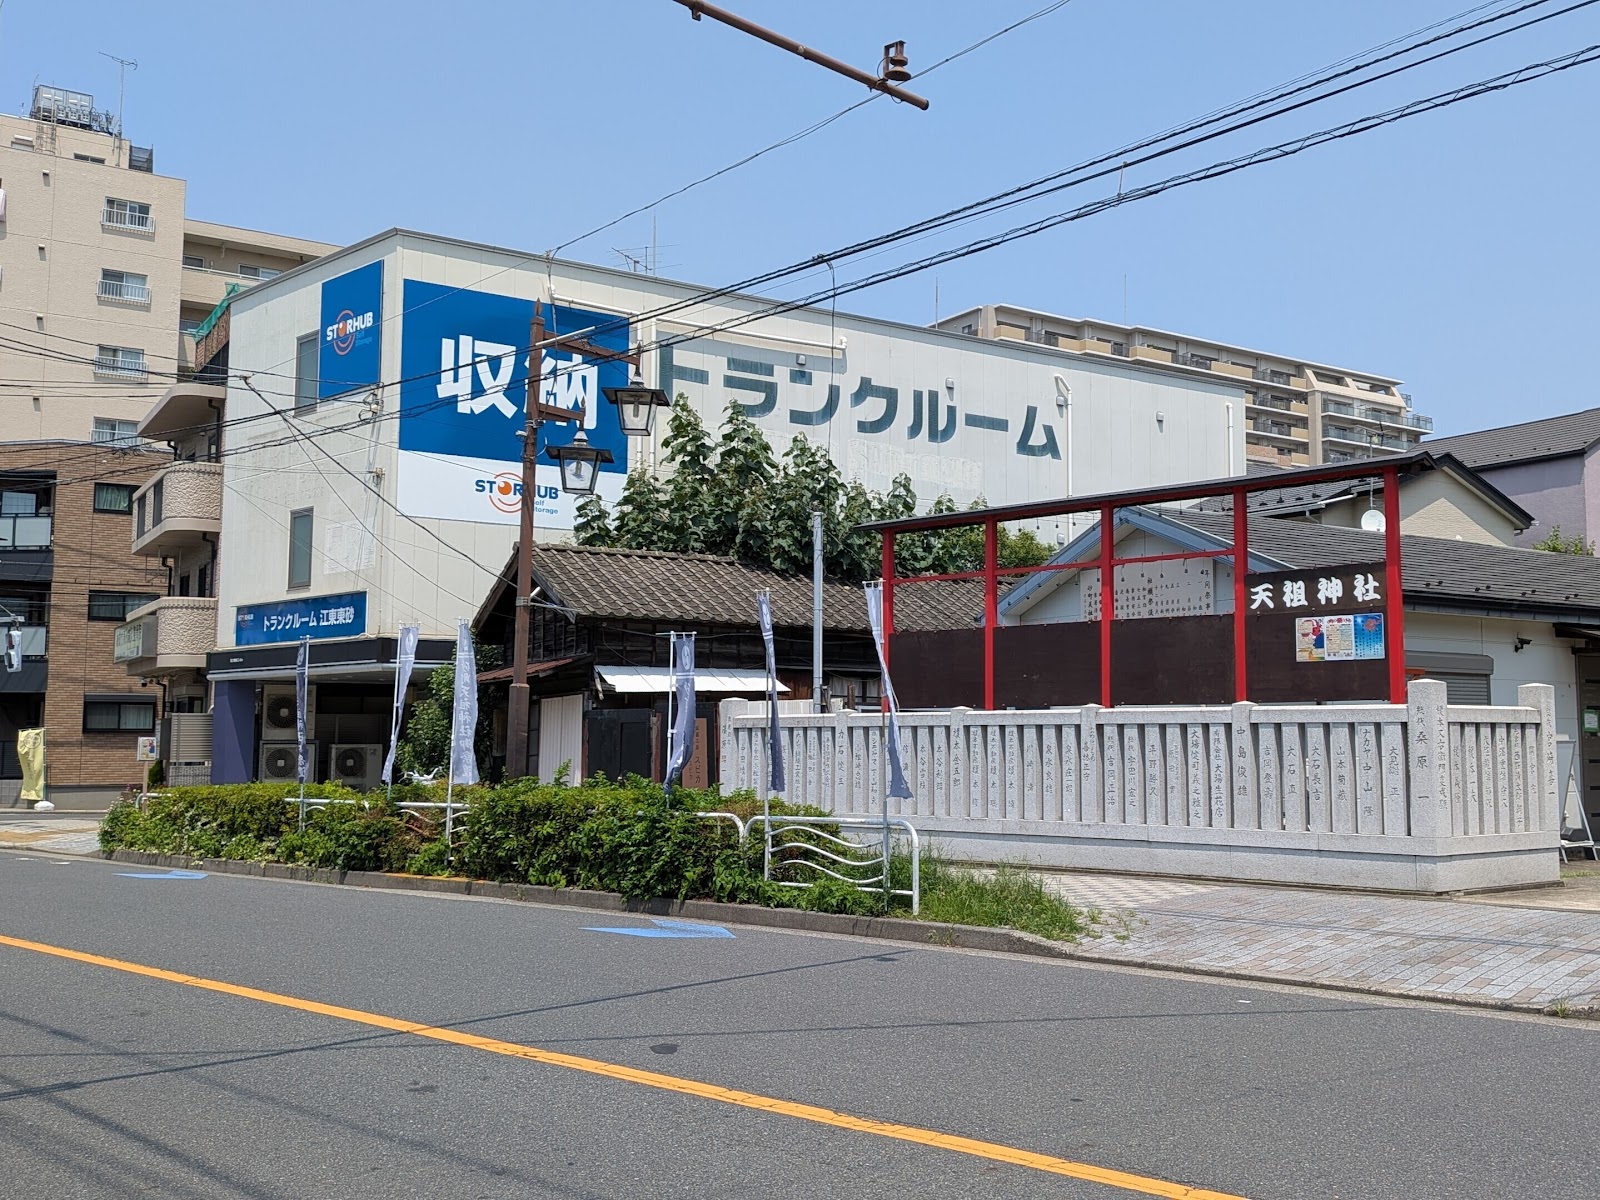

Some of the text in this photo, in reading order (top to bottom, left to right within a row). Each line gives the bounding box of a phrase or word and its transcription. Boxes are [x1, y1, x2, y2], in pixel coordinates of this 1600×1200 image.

[436, 335, 598, 430] 収納
[660, 346, 1062, 460] トランクルーム
[475, 479, 559, 499] STORUB
[1249, 573, 1381, 610] 天祖神社
[263, 606, 355, 632] トランクルーム 江東東砂
